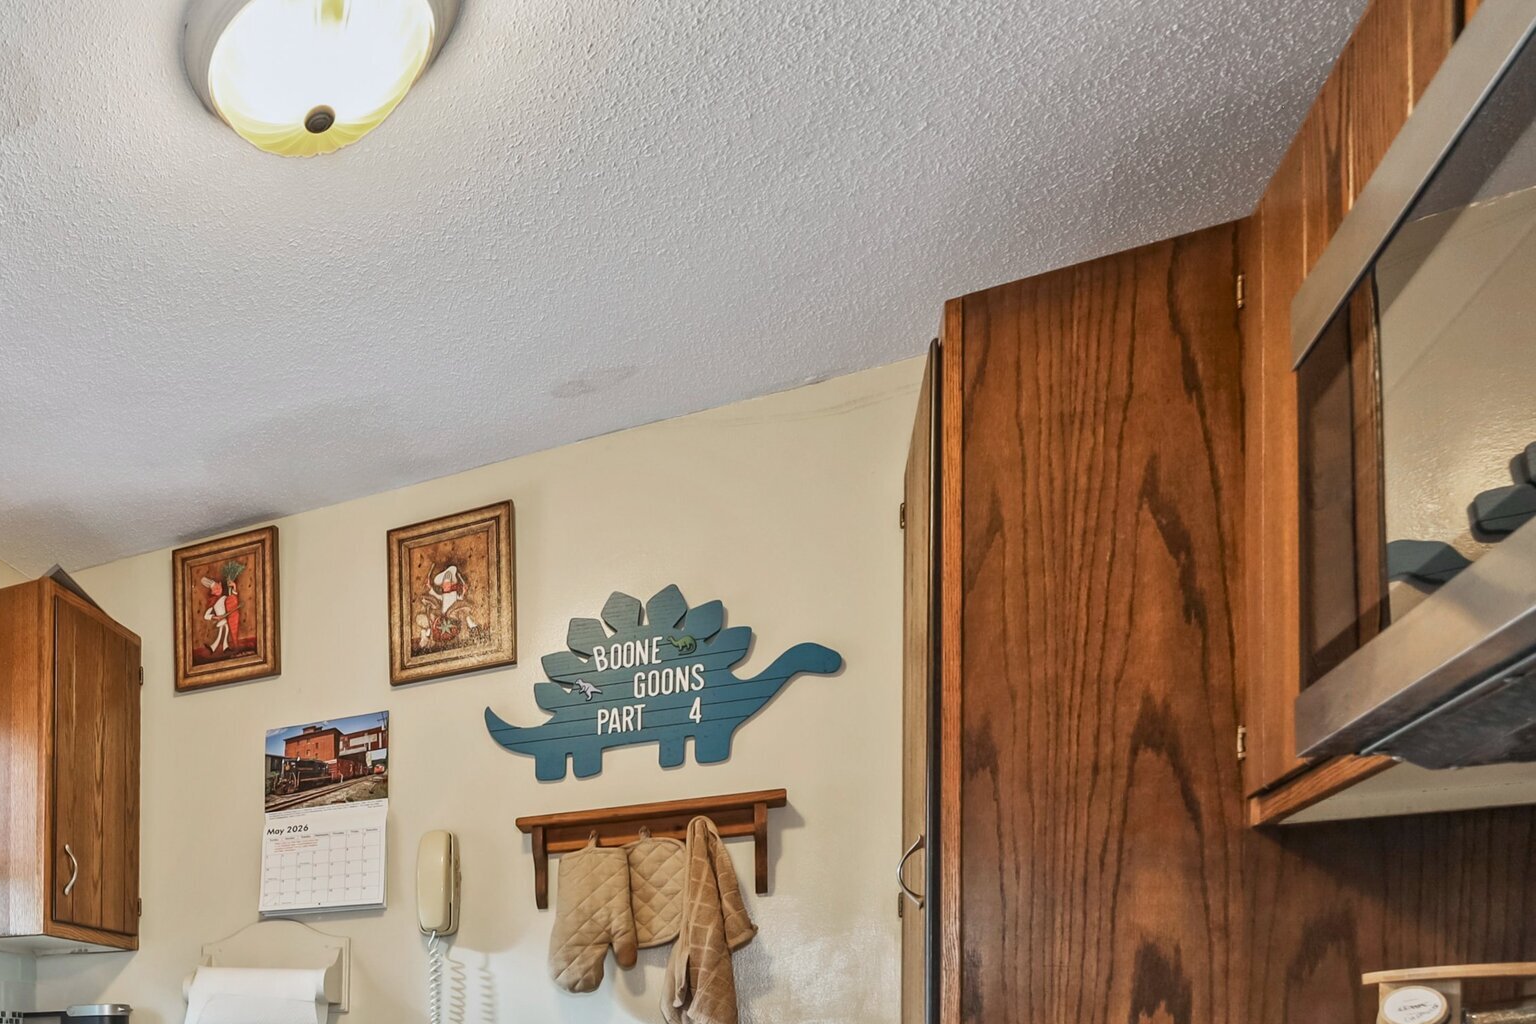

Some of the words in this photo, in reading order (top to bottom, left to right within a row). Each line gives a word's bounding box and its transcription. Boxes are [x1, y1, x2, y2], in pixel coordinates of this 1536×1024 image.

[592, 636, 663, 672] BOONE
[633, 664, 706, 699] GOONS
[596, 703, 646, 735] PART
[689, 697, 703, 724] 4
[266, 828, 285, 836] May
[286, 824, 309, 834] 2026
